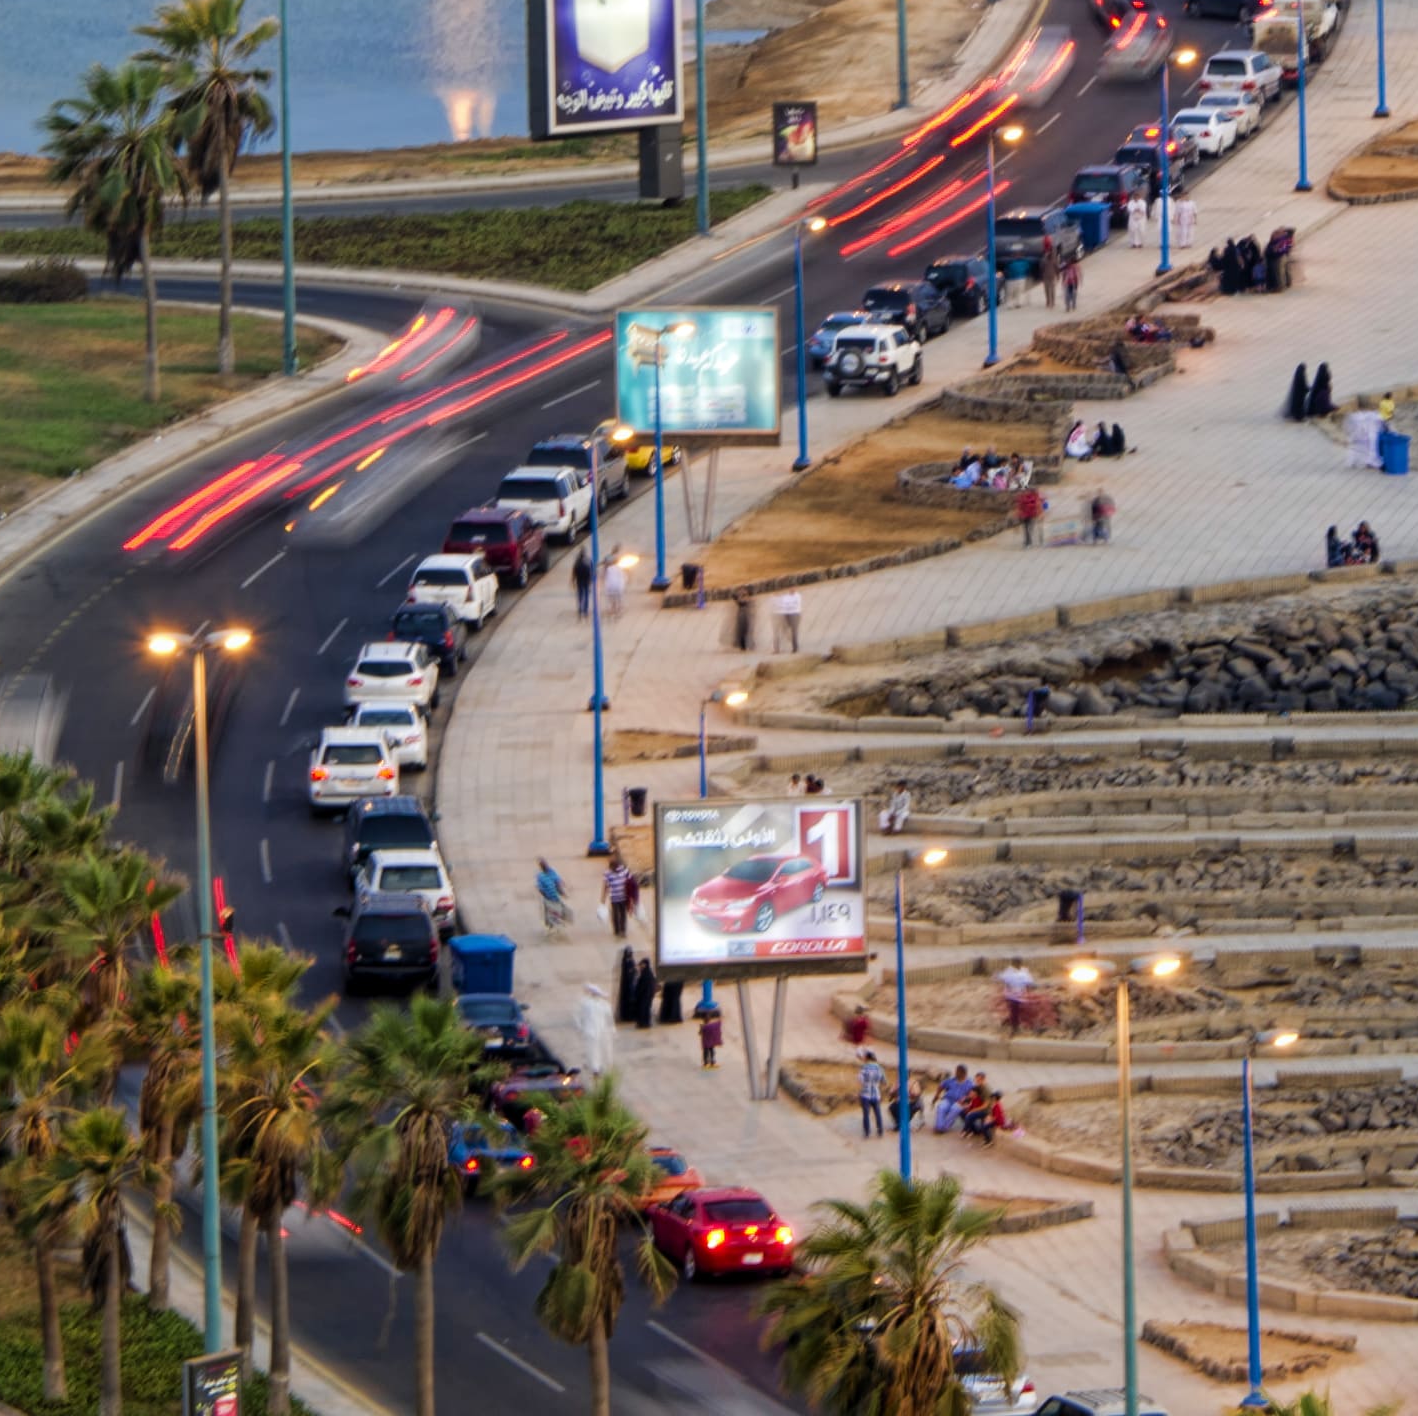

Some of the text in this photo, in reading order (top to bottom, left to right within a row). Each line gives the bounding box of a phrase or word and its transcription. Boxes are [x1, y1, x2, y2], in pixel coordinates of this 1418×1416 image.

[678, 809, 720, 822] TOYOTA
[807, 812, 839, 878] 1
[770, 939, 848, 955] COROLLA
